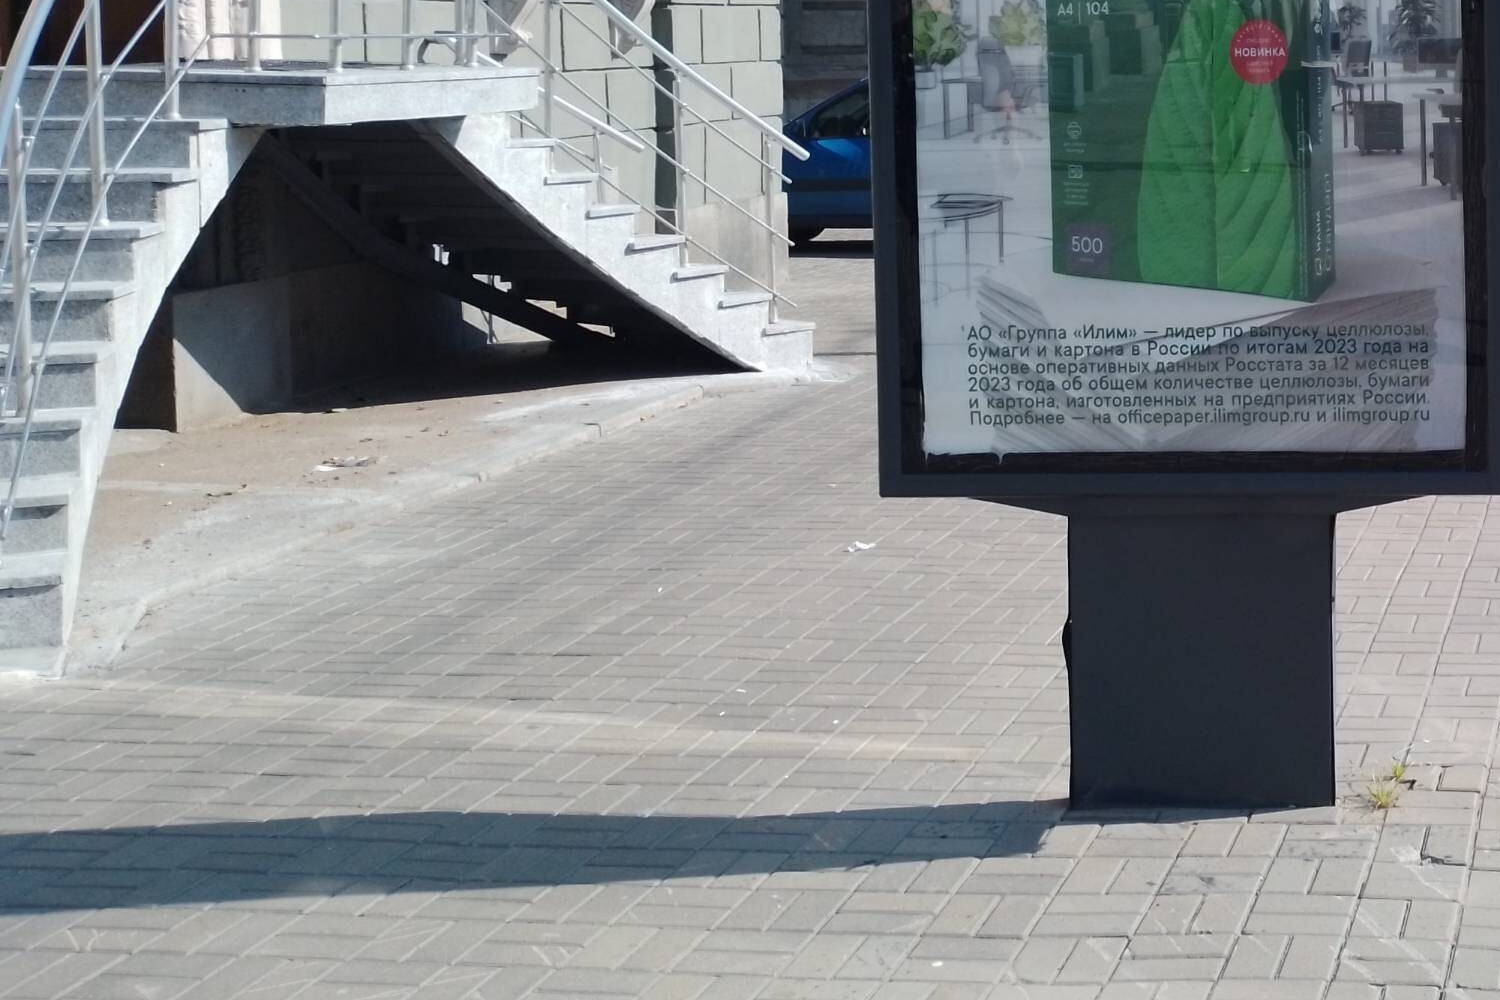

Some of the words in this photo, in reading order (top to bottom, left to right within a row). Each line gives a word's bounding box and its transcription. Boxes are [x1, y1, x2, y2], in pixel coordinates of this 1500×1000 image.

[1086, 1, 1110, 16] 104
[1234, 47, 1286, 58] НОВИНКА
[1071, 236, 1103, 254] 500
[967, 325, 992, 340] АО
[999, 325, 1067, 343] «Группа
[1073, 324, 1137, 340] «Илим»
[1165, 326, 1216, 342] лидер
[1223, 326, 1243, 338] по
[1250, 325, 1320, 340] выпуску
[968, 343, 1030, 361] бумаги
[1037, 345, 1047, 357] и
[1054, 344, 1124, 360] картона
[1131, 344, 1141, 356] в
[1147, 340, 1210, 356] России
[1219, 342, 1240, 355] по
[1246, 342, 1308, 355] итогам
[1314, 339, 1357, 354] 2023
[1363, 341, 1401, 356] года
[1408, 341, 1429, 353] на
[968, 363, 1030, 376] основе
[1035, 361, 1150, 378] оперативных
[1155, 360, 1220, 376] данных
[1225, 357, 1303, 372] Росстата
[1308, 359, 1327, 371] за
[1333, 356, 1349, 371] 12
[1355, 358, 1429, 373] месяцев
[968, 377, 1011, 392] 2023
[1017, 379, 1055, 394] года
[1061, 376, 1082, 391] об
[1088, 375, 1148, 393] общем
[1153, 376, 1253, 392] количестве
[1367, 372, 1430, 390] бумаги
[969, 398, 979, 409] и
[1066, 394, 1196, 409] изготовленных
[1203, 394, 1224, 406] на
[1231, 392, 1356, 408] предприятиях
[970, 411, 1065, 428] Подробнее
[1092, 412, 1112, 424] на
[1117, 407, 1310, 427] officepaper.ilimgroup.ru
[1316, 410, 1327, 422] и
[1333, 407, 1430, 424] ilimgroup.ru
